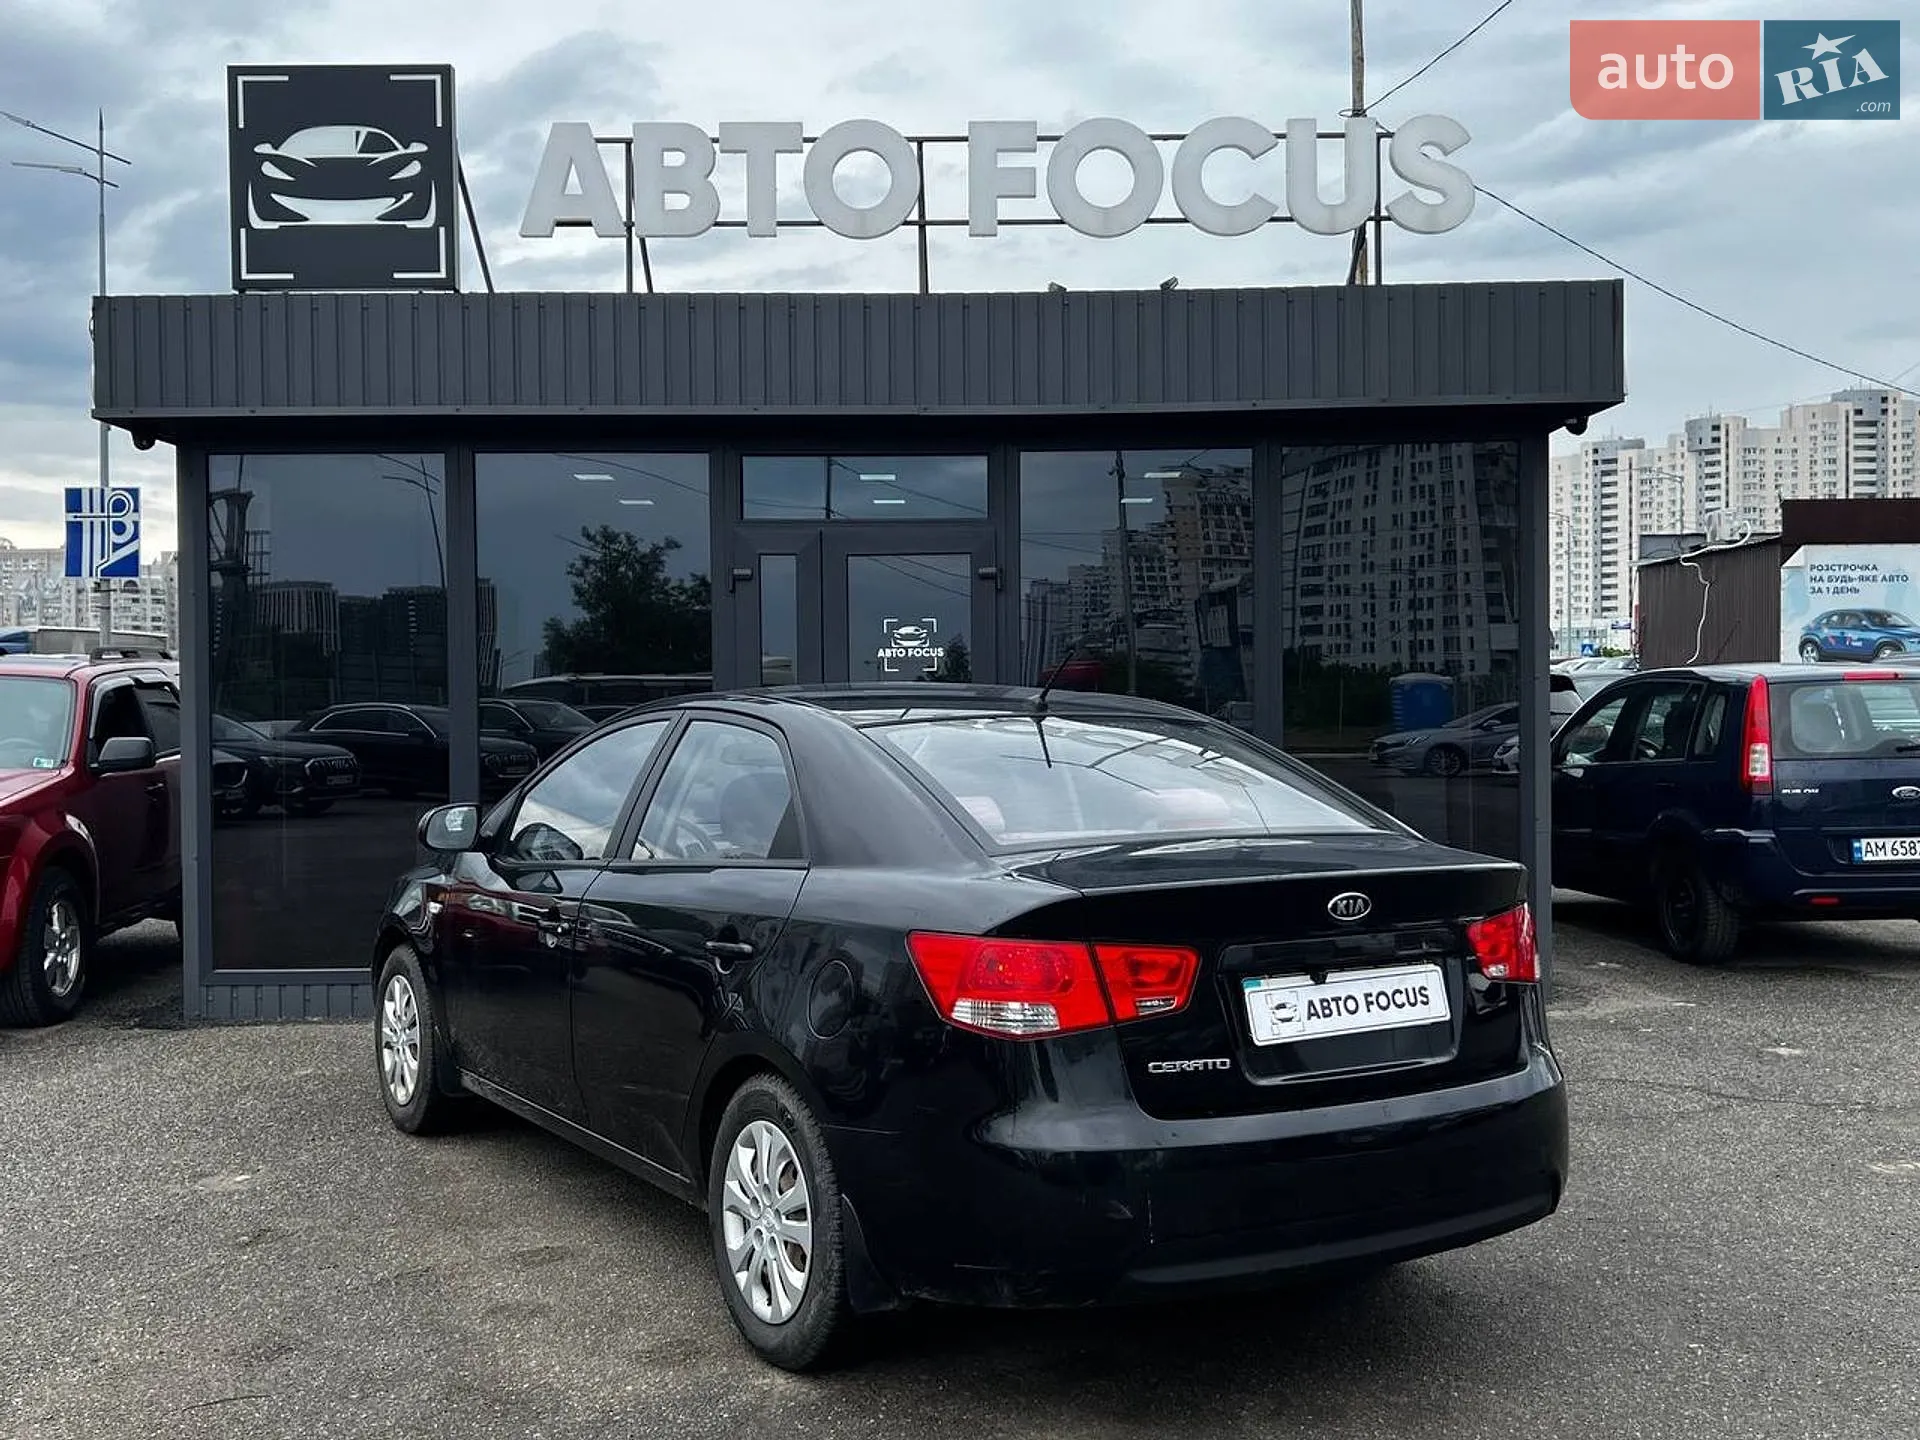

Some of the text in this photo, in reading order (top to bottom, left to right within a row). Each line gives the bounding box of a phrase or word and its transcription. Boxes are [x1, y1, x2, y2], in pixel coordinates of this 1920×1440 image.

[519, 114, 1476, 240] АВТО FOCUS
[1810, 573, 1909, 583] НА БУДЬ-ЯКЕ АВТО
[1810, 586, 1860, 595] ЗА 1 ДЕНЬ
[878, 648, 944, 657] АВТО FOCUS
[1864, 841, 1887, 857] AM
[1336, 898, 1366, 915] KIA
[1306, 985, 1431, 1021] АВТО FOCUS
[1147, 1058, 1232, 1074] CERATO
